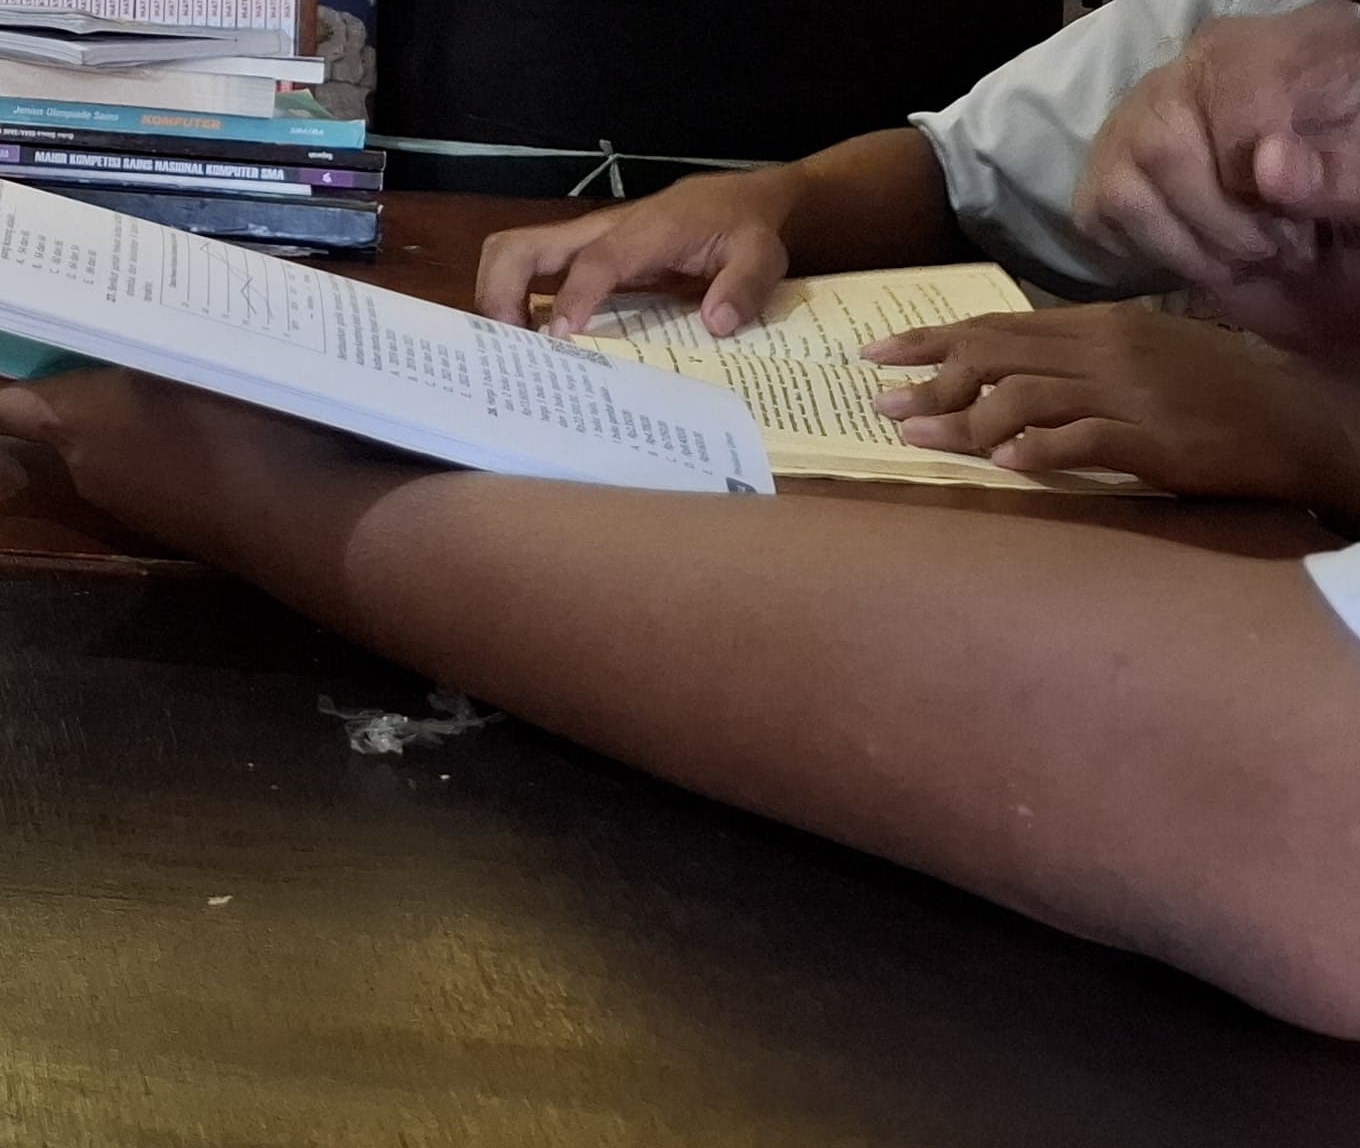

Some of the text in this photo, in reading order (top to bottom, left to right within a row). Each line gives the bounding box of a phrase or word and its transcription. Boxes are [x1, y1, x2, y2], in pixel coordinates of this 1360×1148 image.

[141, 114, 222, 129] KOMPUTER
[34, 151, 284, 181] MAHIR KOMPETISI SAINS NASIONAL KOMPUTER SMA
